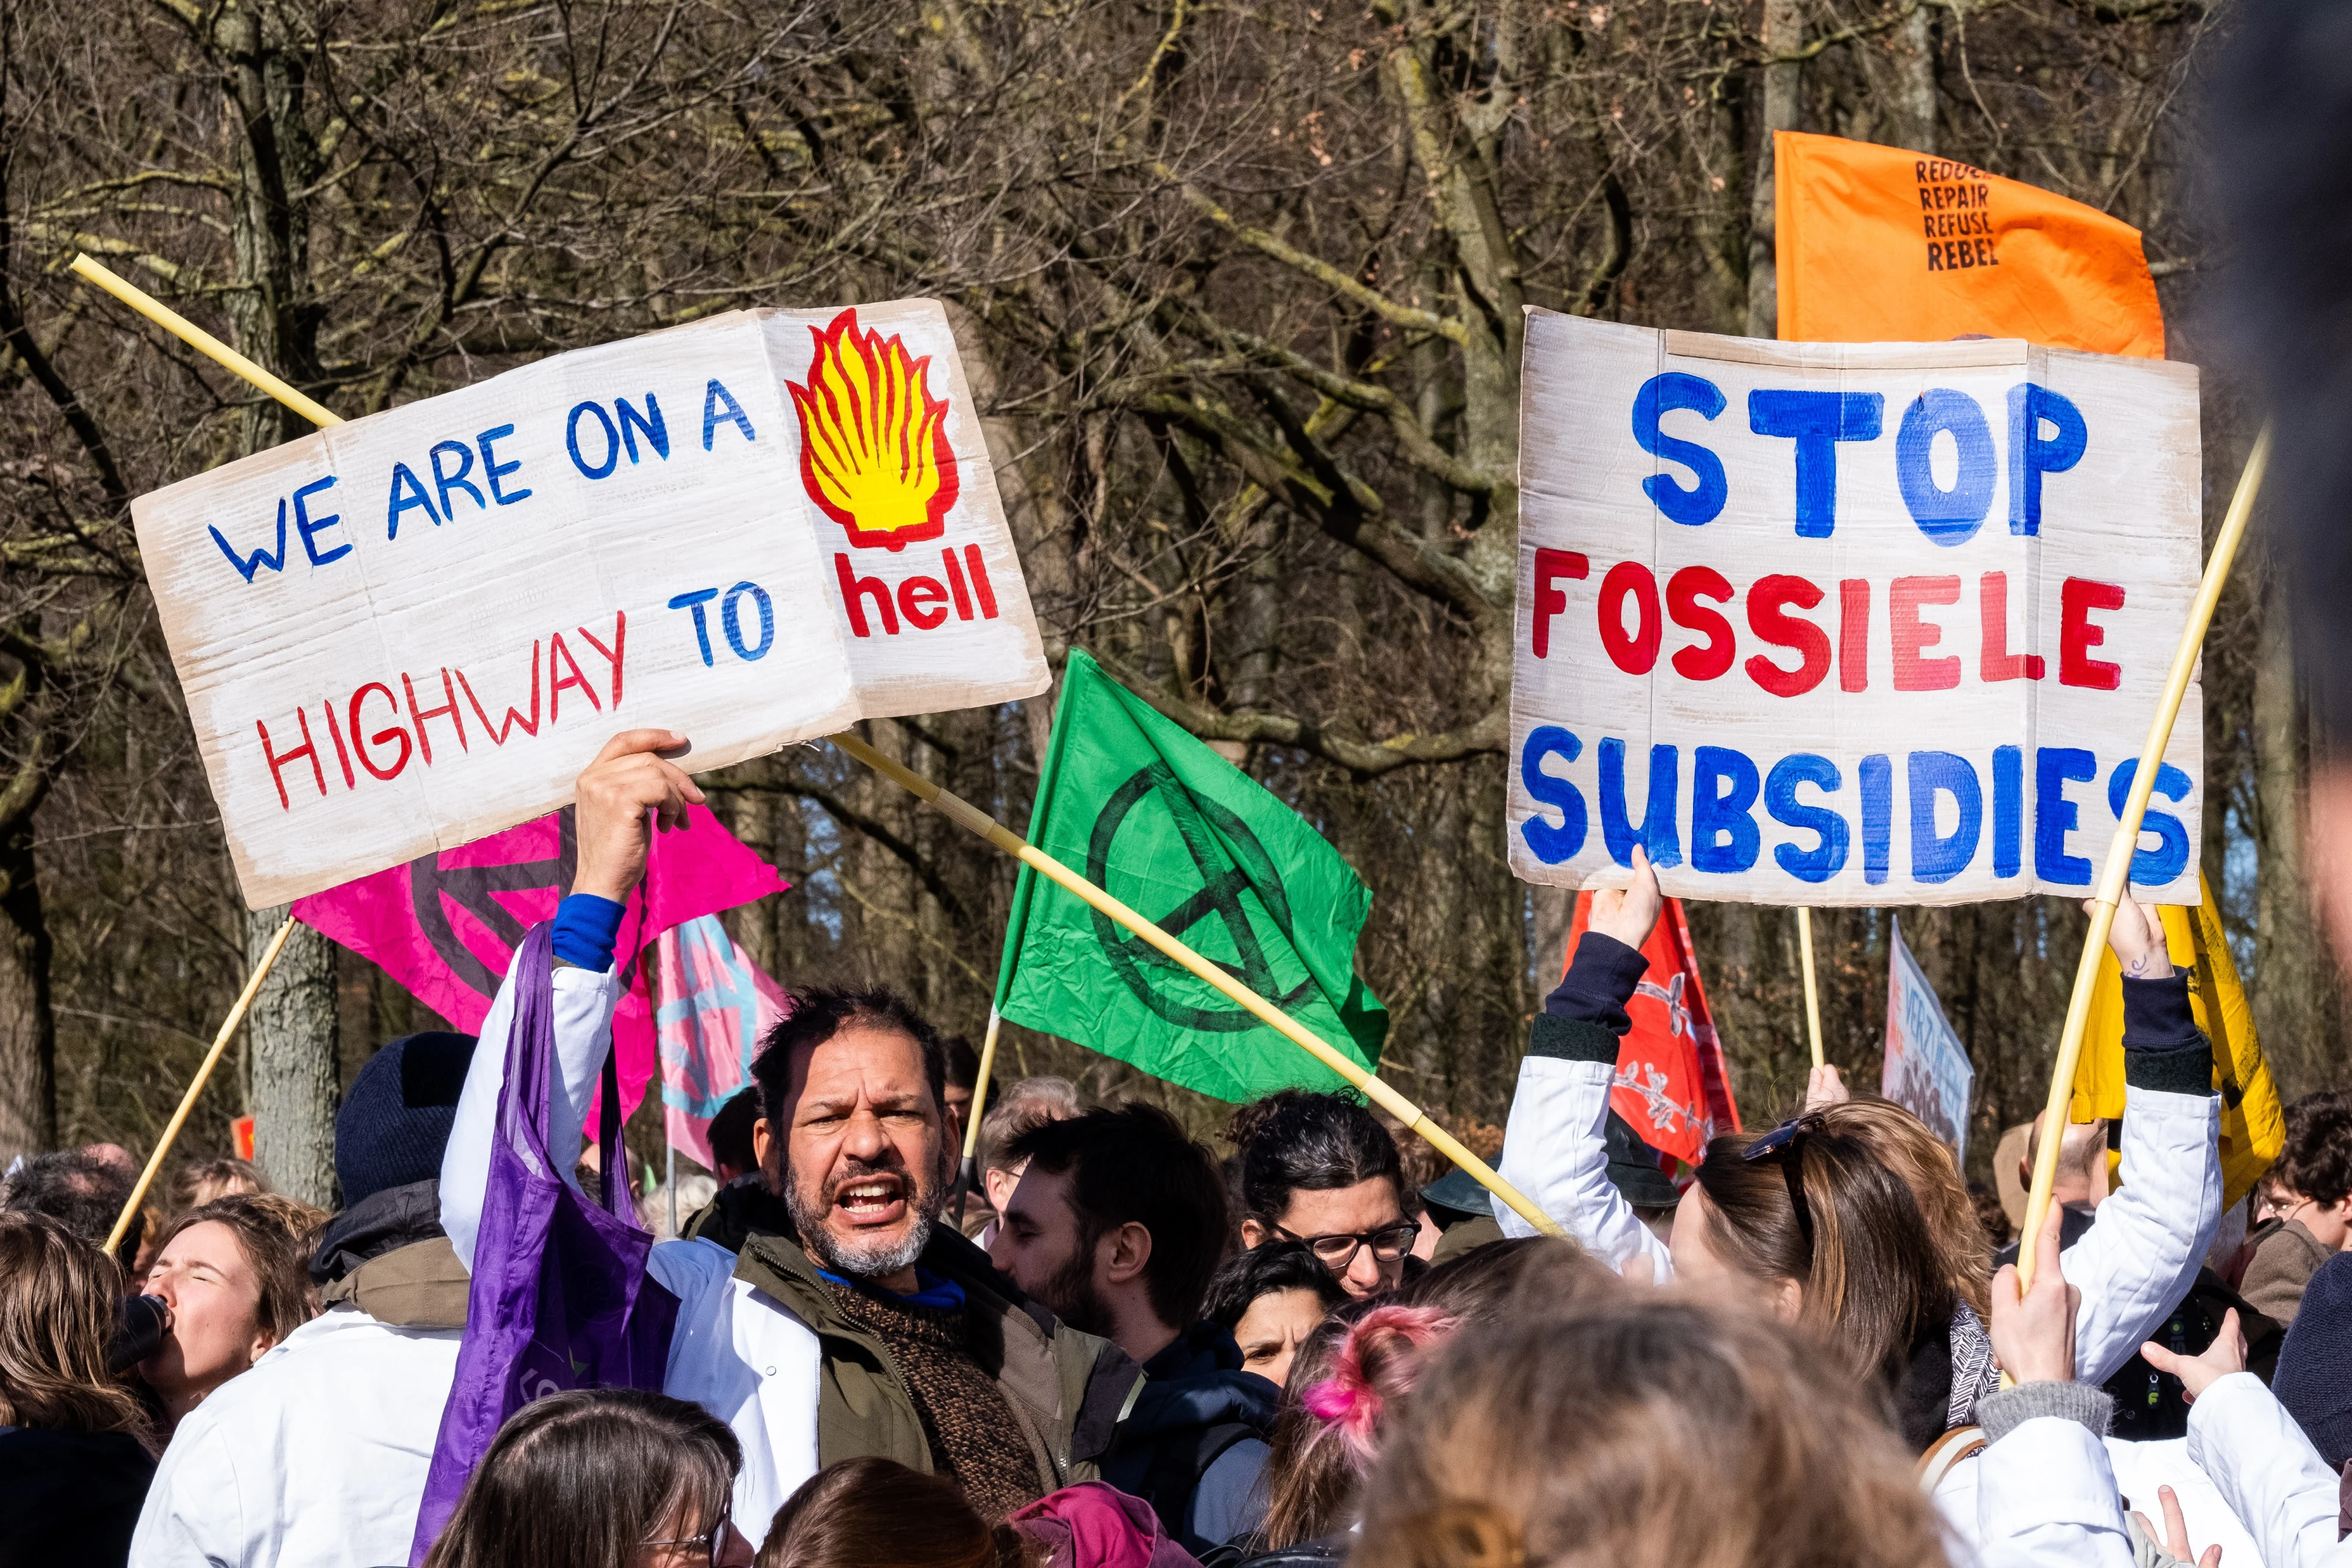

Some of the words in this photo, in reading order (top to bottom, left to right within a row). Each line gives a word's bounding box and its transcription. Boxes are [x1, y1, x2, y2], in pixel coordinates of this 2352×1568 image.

[1919, 184, 1989, 211] REPAIR
[1923, 211, 1994, 238] REFUSE
[1927, 238, 2000, 271] REBEL
[207, 475, 353, 584] WE
[388, 423, 533, 541] ARE
[565, 391, 671, 480] ON
[702, 378, 756, 452] A
[1632, 371, 2087, 548] STOP
[834, 543, 999, 638] hell
[1531, 547, 2126, 698] FOSSIELE
[256, 609, 627, 813] HIGHWAY
[667, 581, 775, 668] TO
[1520, 725, 2195, 888] SUBSIDIES
